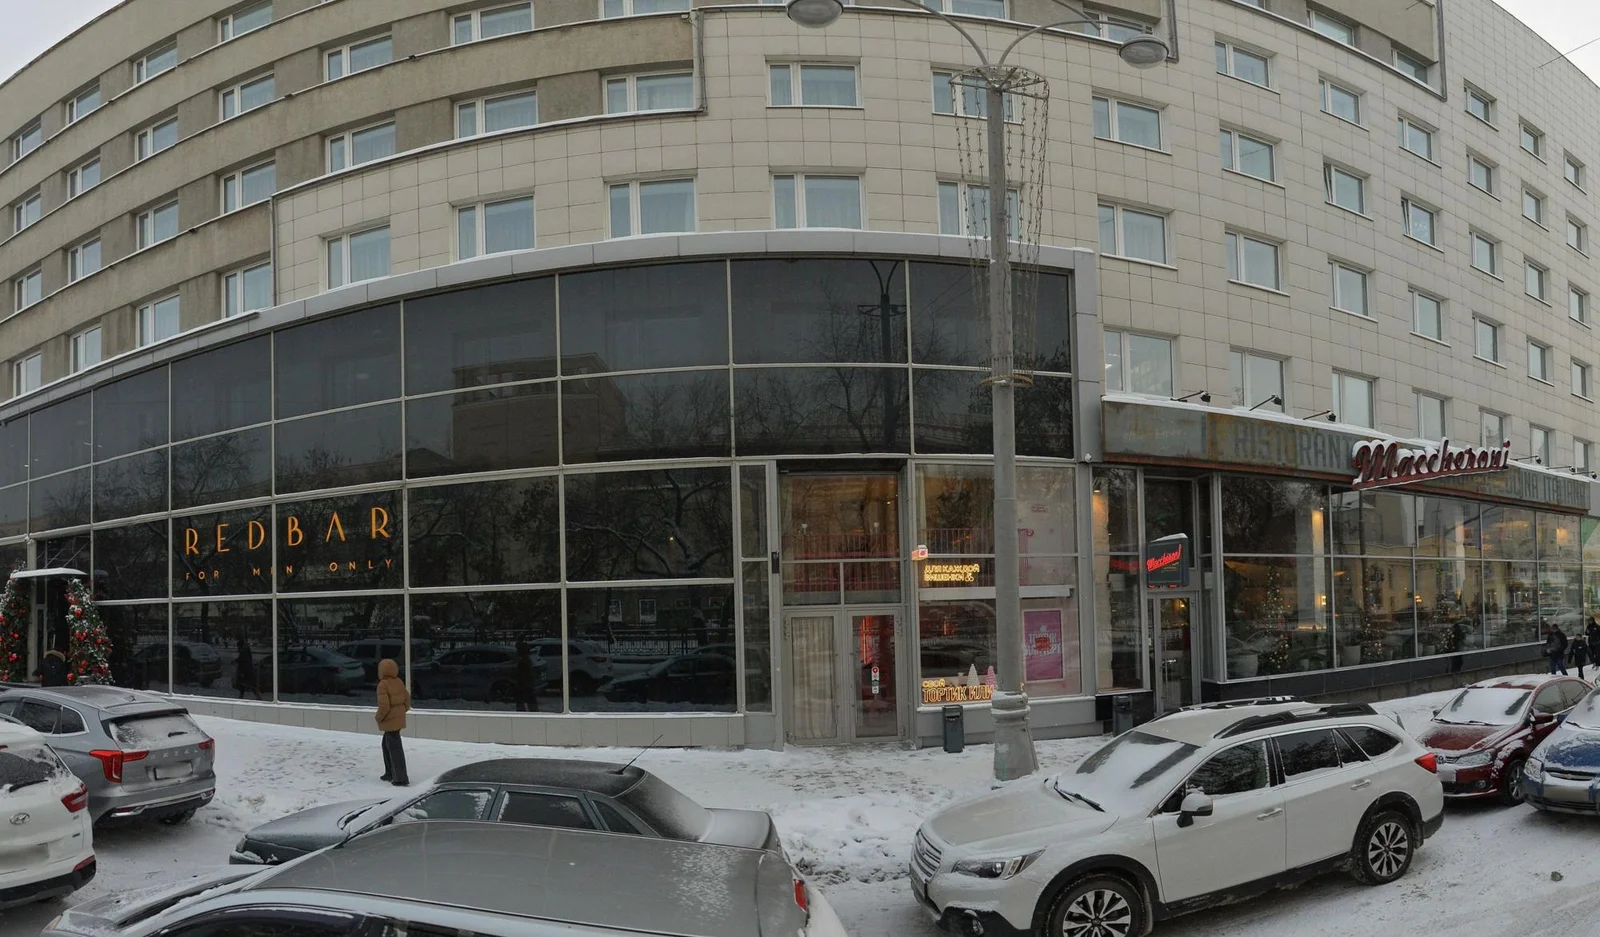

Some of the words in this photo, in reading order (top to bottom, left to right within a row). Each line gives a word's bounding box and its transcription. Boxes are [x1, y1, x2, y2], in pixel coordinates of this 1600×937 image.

[1353, 437, 1510, 483] Maccheroni
[185, 570, 220, 581] FOR
[329, 558, 392, 572] ONLY
[922, 685, 967, 703] ТОРТИК
